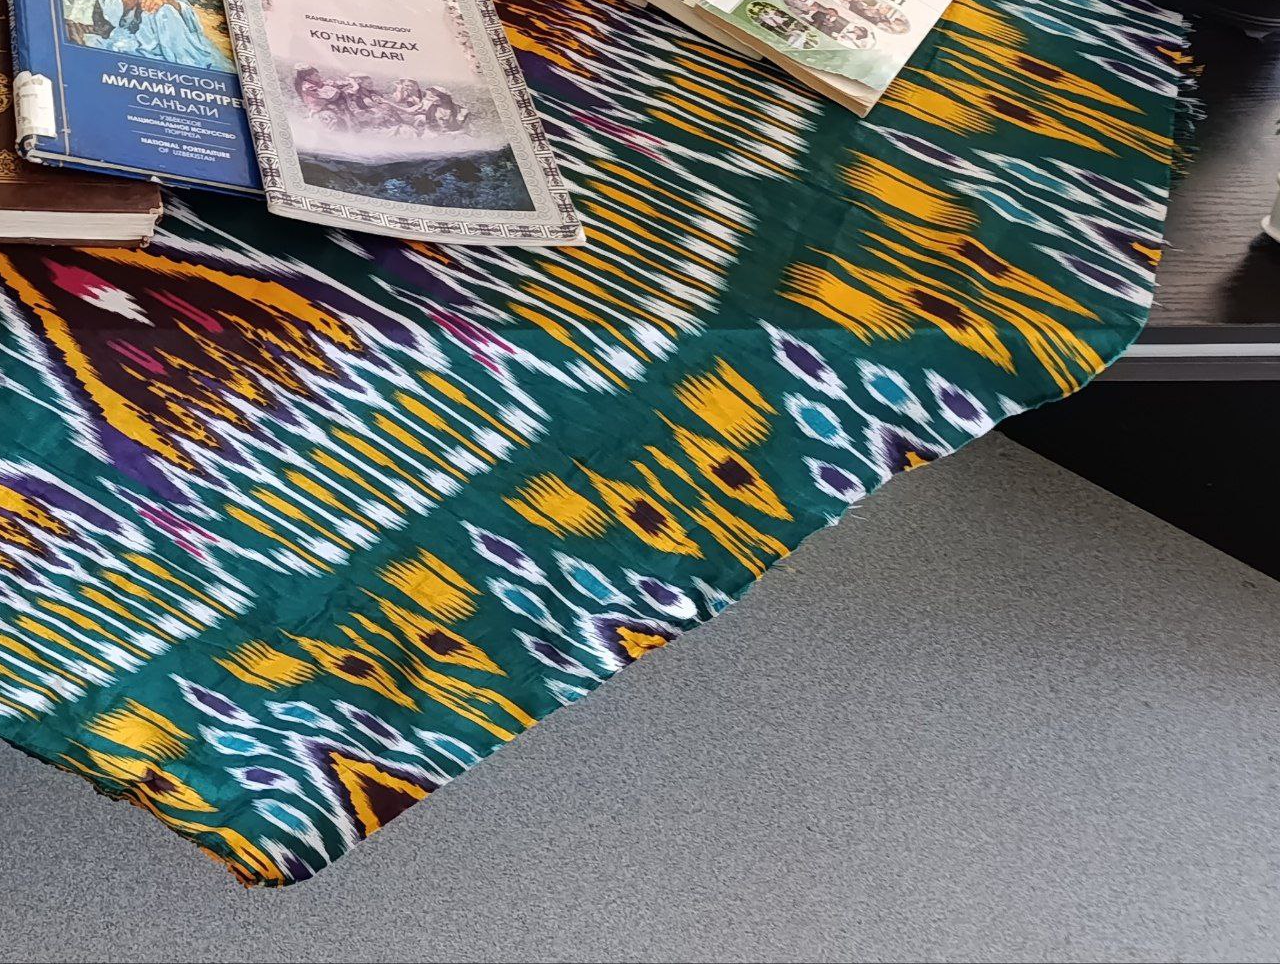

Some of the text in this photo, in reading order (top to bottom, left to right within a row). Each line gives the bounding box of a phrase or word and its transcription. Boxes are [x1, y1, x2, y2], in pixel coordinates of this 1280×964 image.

[331, 44, 405, 61] NAVOLARI
[370, 39, 419, 52] JIZZAX
[101, 73, 176, 96] МИЛЛИЙ
[117, 61, 227, 92] ЎЗБЕКИСТОН
[136, 94, 220, 119] САНЪАТИ
[140, 137, 180, 149] NATIONAL
